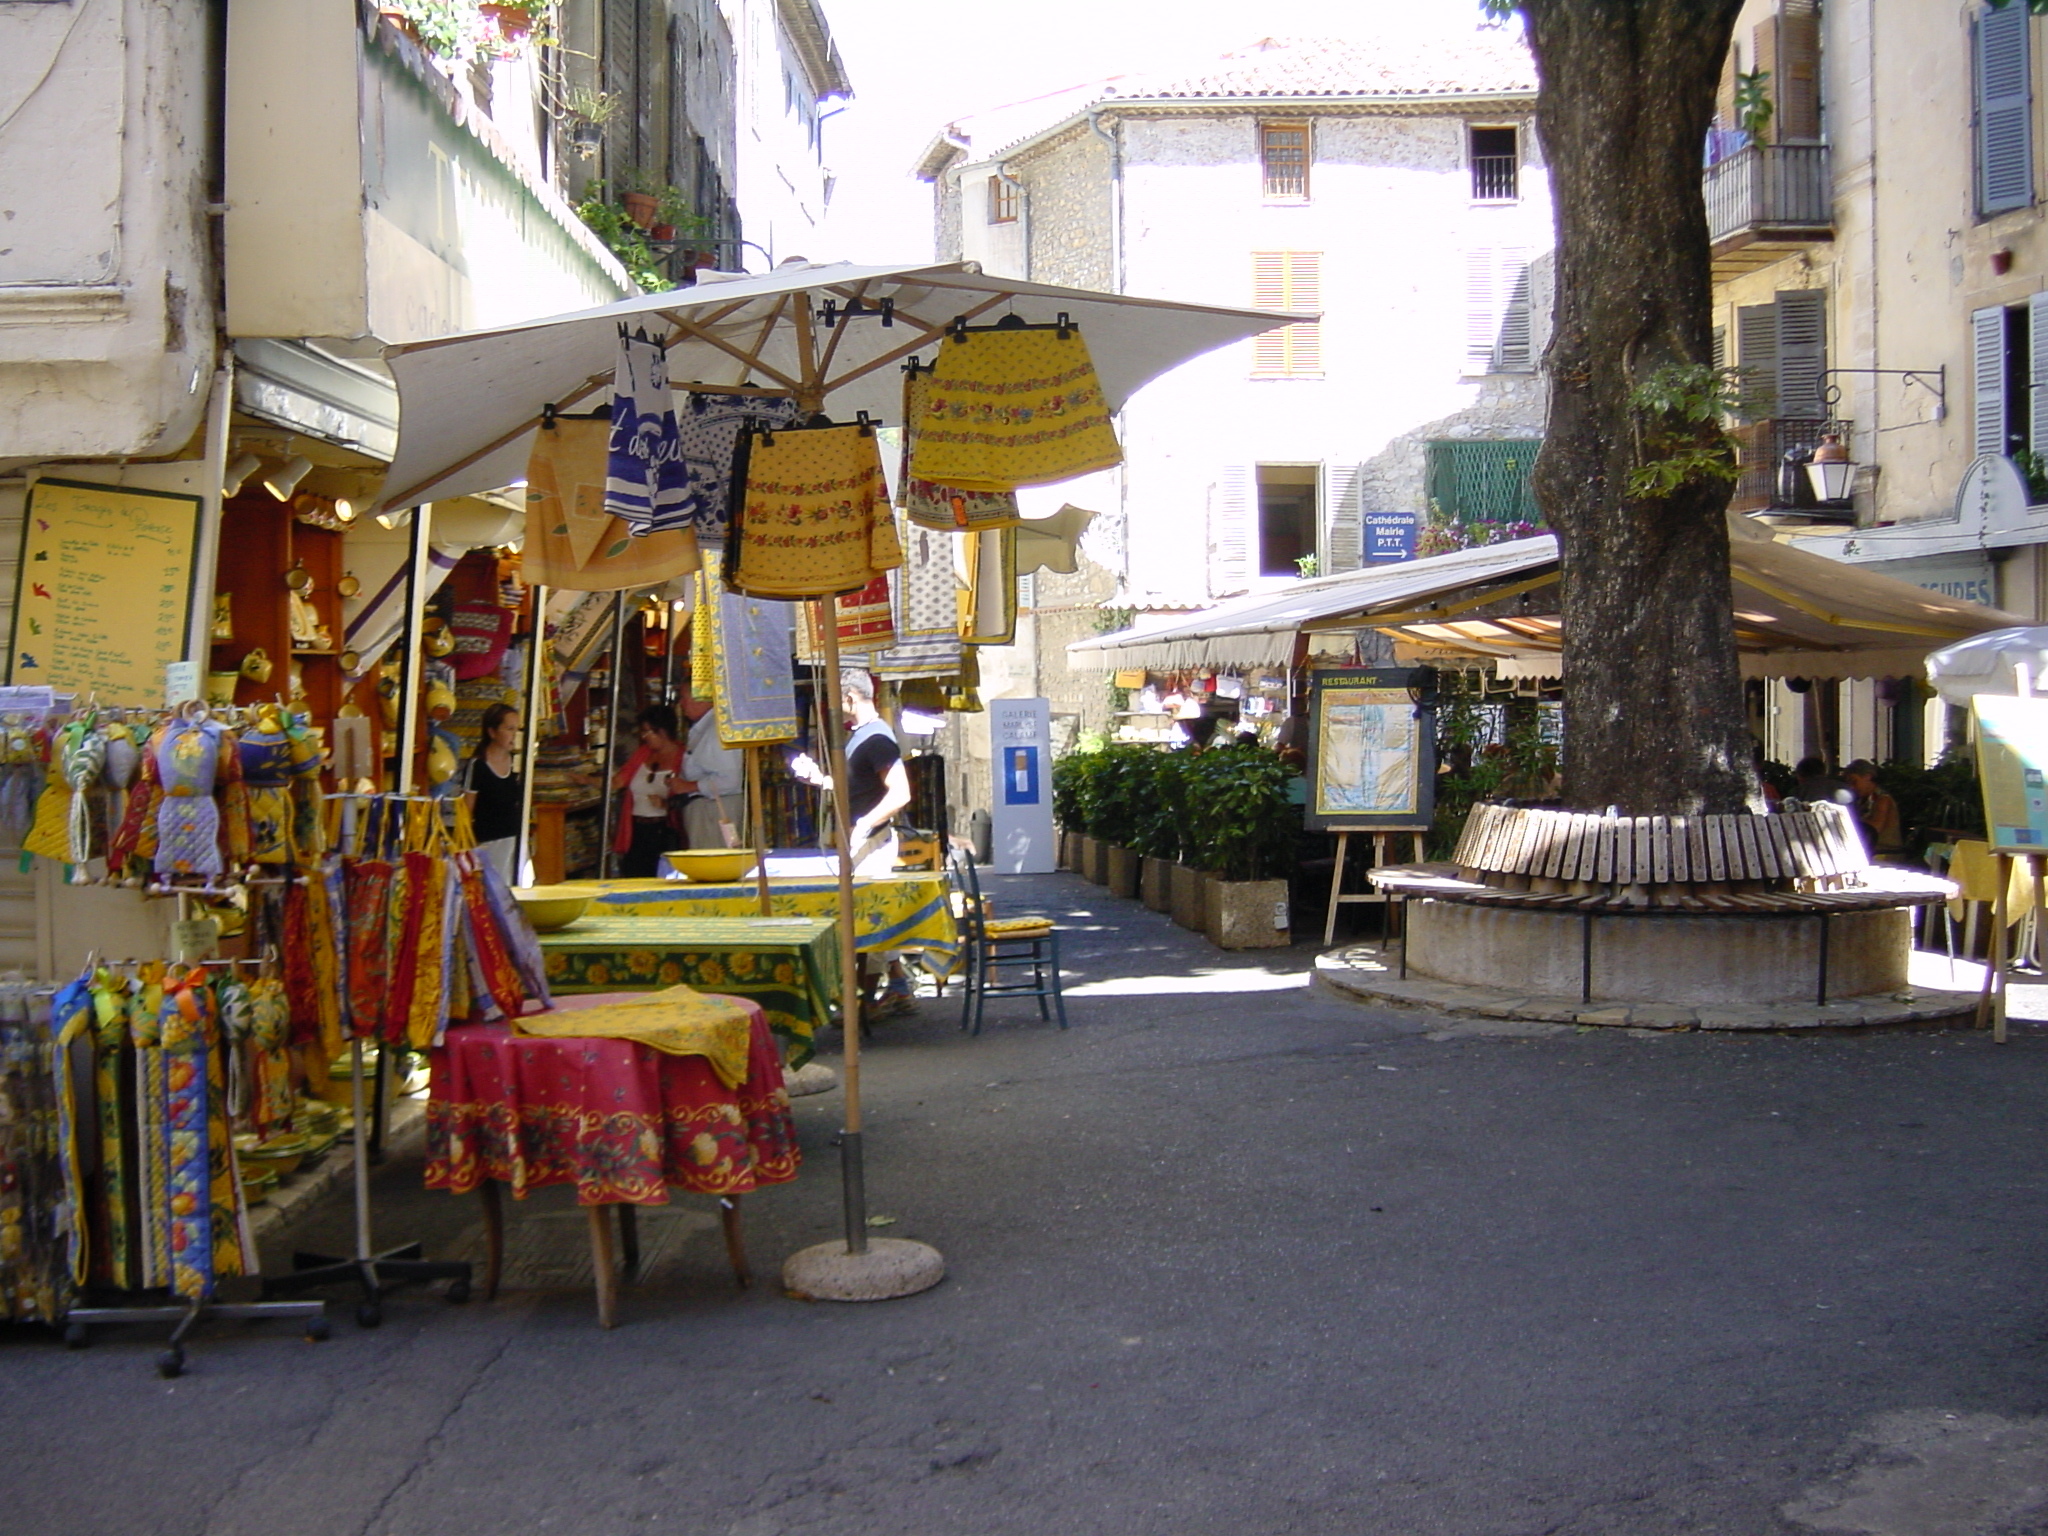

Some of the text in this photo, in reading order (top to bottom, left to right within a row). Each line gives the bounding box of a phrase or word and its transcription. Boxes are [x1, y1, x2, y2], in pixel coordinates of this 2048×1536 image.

[1365, 515, 1415, 525] Cathédrale
[1376, 526, 1405, 536] Mairie
[1377, 538, 1403, 547] P.T.T.
[1321, 676, 1377, 686] RESTAURANT
[1002, 711, 1037, 719] GALERIE
